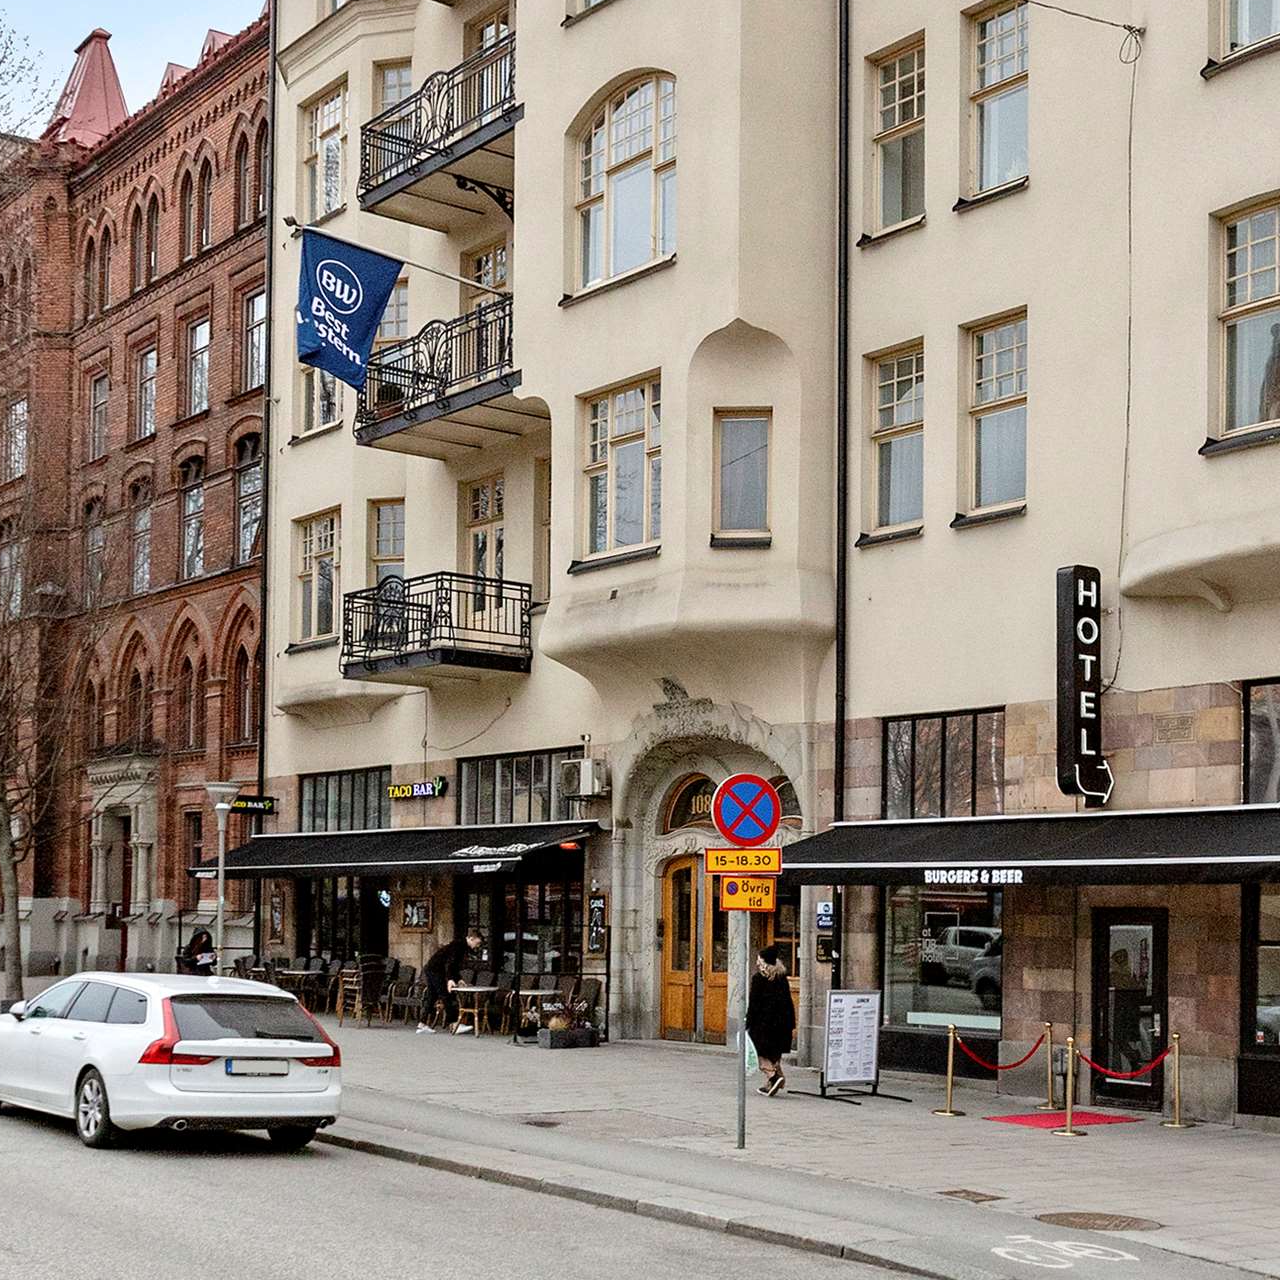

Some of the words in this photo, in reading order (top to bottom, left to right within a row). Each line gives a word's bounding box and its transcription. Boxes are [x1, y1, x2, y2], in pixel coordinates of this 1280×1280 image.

[321, 269, 357, 305] BW
[311, 296, 350, 340] Best
[1076, 579, 1099, 756] HOTEL
[387, 785, 412, 798] TACO
[413, 783, 433, 796] BAR
[691, 794, 711, 814] 108
[715, 855, 771, 866] 15-18.30
[924, 869, 979, 884] BURGERS
[980, 870, 989, 884] &
[991, 869, 1023, 884] BEER
[741, 880, 770, 896] Övrig
[748, 898, 762, 907] tid
